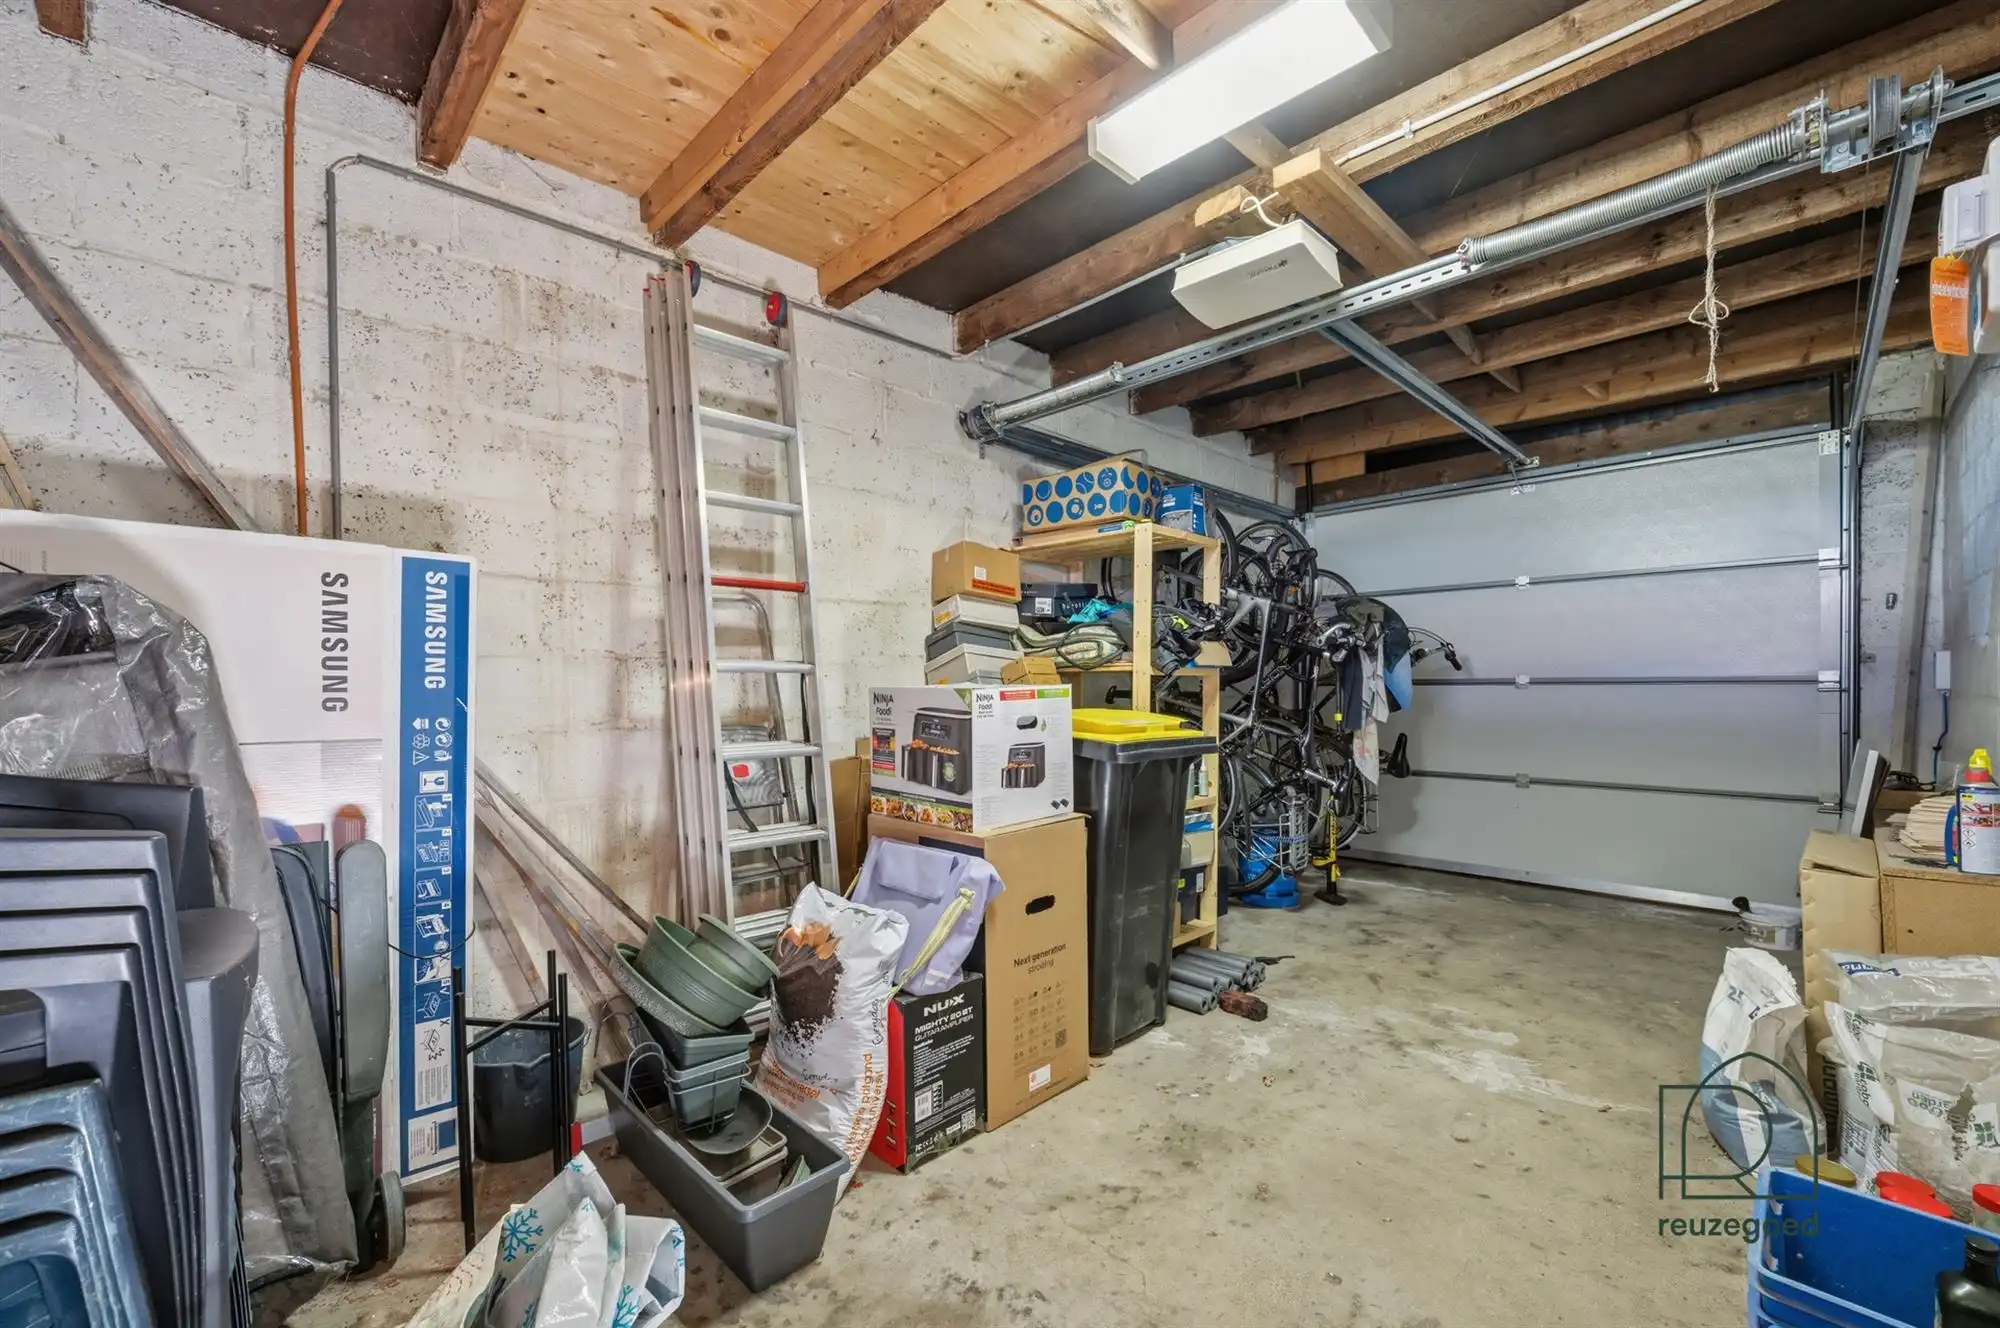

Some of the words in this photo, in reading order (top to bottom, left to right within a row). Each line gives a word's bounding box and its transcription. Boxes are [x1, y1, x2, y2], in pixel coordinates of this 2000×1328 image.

[321, 572, 349, 712] SAMSUNG
[425, 571, 448, 689] SAMSUNG
[873, 691, 894, 707] NINJA
[976, 692, 994, 704] NINJA
[1013, 955, 1031, 968] Next
[1031, 943, 1067, 963] generation
[923, 993, 965, 1017] NUX
[914, 1015, 949, 1035] MIGHTY
[914, 1026, 940, 1042] GUITAR
[940, 1013, 974, 1031] AMPLIFIER
